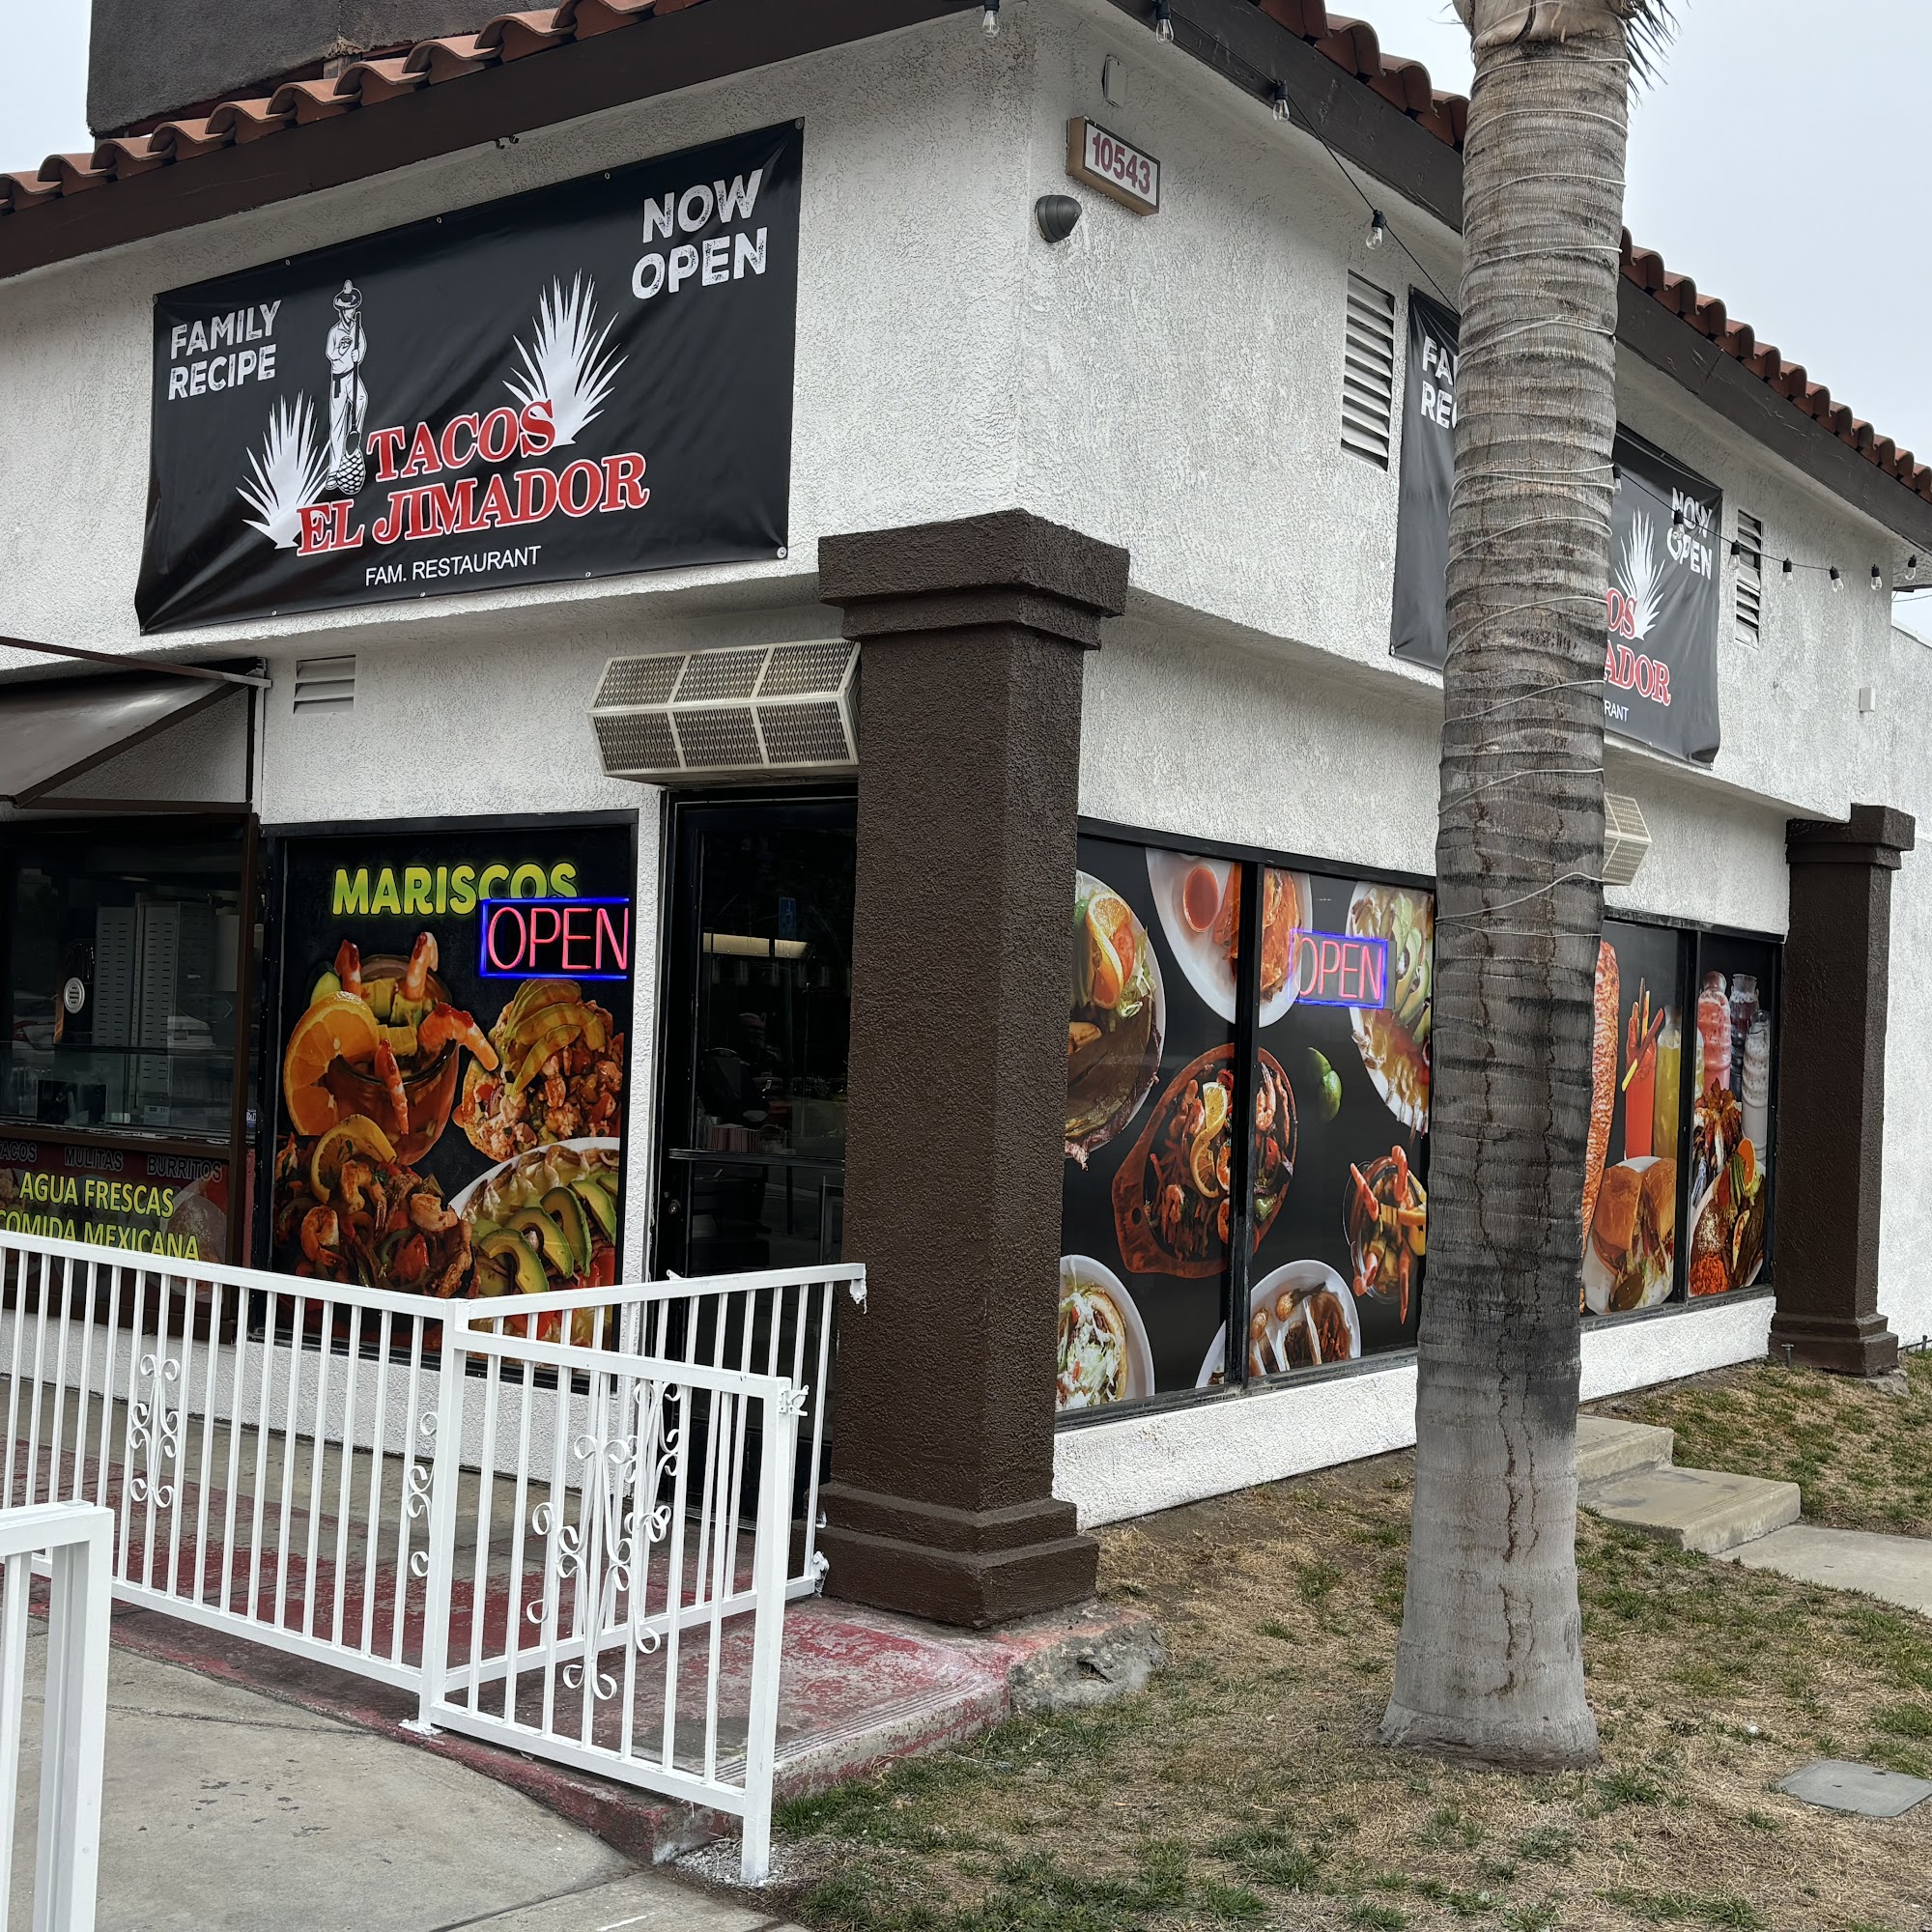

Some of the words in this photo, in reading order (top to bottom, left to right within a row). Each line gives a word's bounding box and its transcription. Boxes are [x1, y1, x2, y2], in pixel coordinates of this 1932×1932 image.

[1093, 132, 1151, 194] 10543
[642, 168, 764, 244] NOW
[630, 226, 769, 300] OPEN
[170, 299, 282, 360] FAMILY
[167, 344, 277, 401] RECIPE
[366, 398, 557, 483] TACOS
[295, 498, 364, 557] EL
[371, 450, 651, 546] JIMADOR
[1671, 486, 1713, 538] NOW
[364, 566, 407, 587] FAM.
[412, 544, 543, 582] RESTAURANT
[1666, 524, 1713, 581] OPEN
[1604, 639, 1672, 707] ADOR
[331, 862, 580, 917] MARISCOS
[488, 906, 629, 970] OPEN
[1293, 936, 1383, 1001] OPEN
[0, 1140, 38, 1163] ACOS
[64, 1146, 124, 1172] MULITAS
[147, 1154, 222, 1183] BURRITOS
[19, 1172, 78, 1207] AGUA
[84, 1179, 176, 1219] FRESCAS
[83, 1221, 201, 1262] MEXICANA
